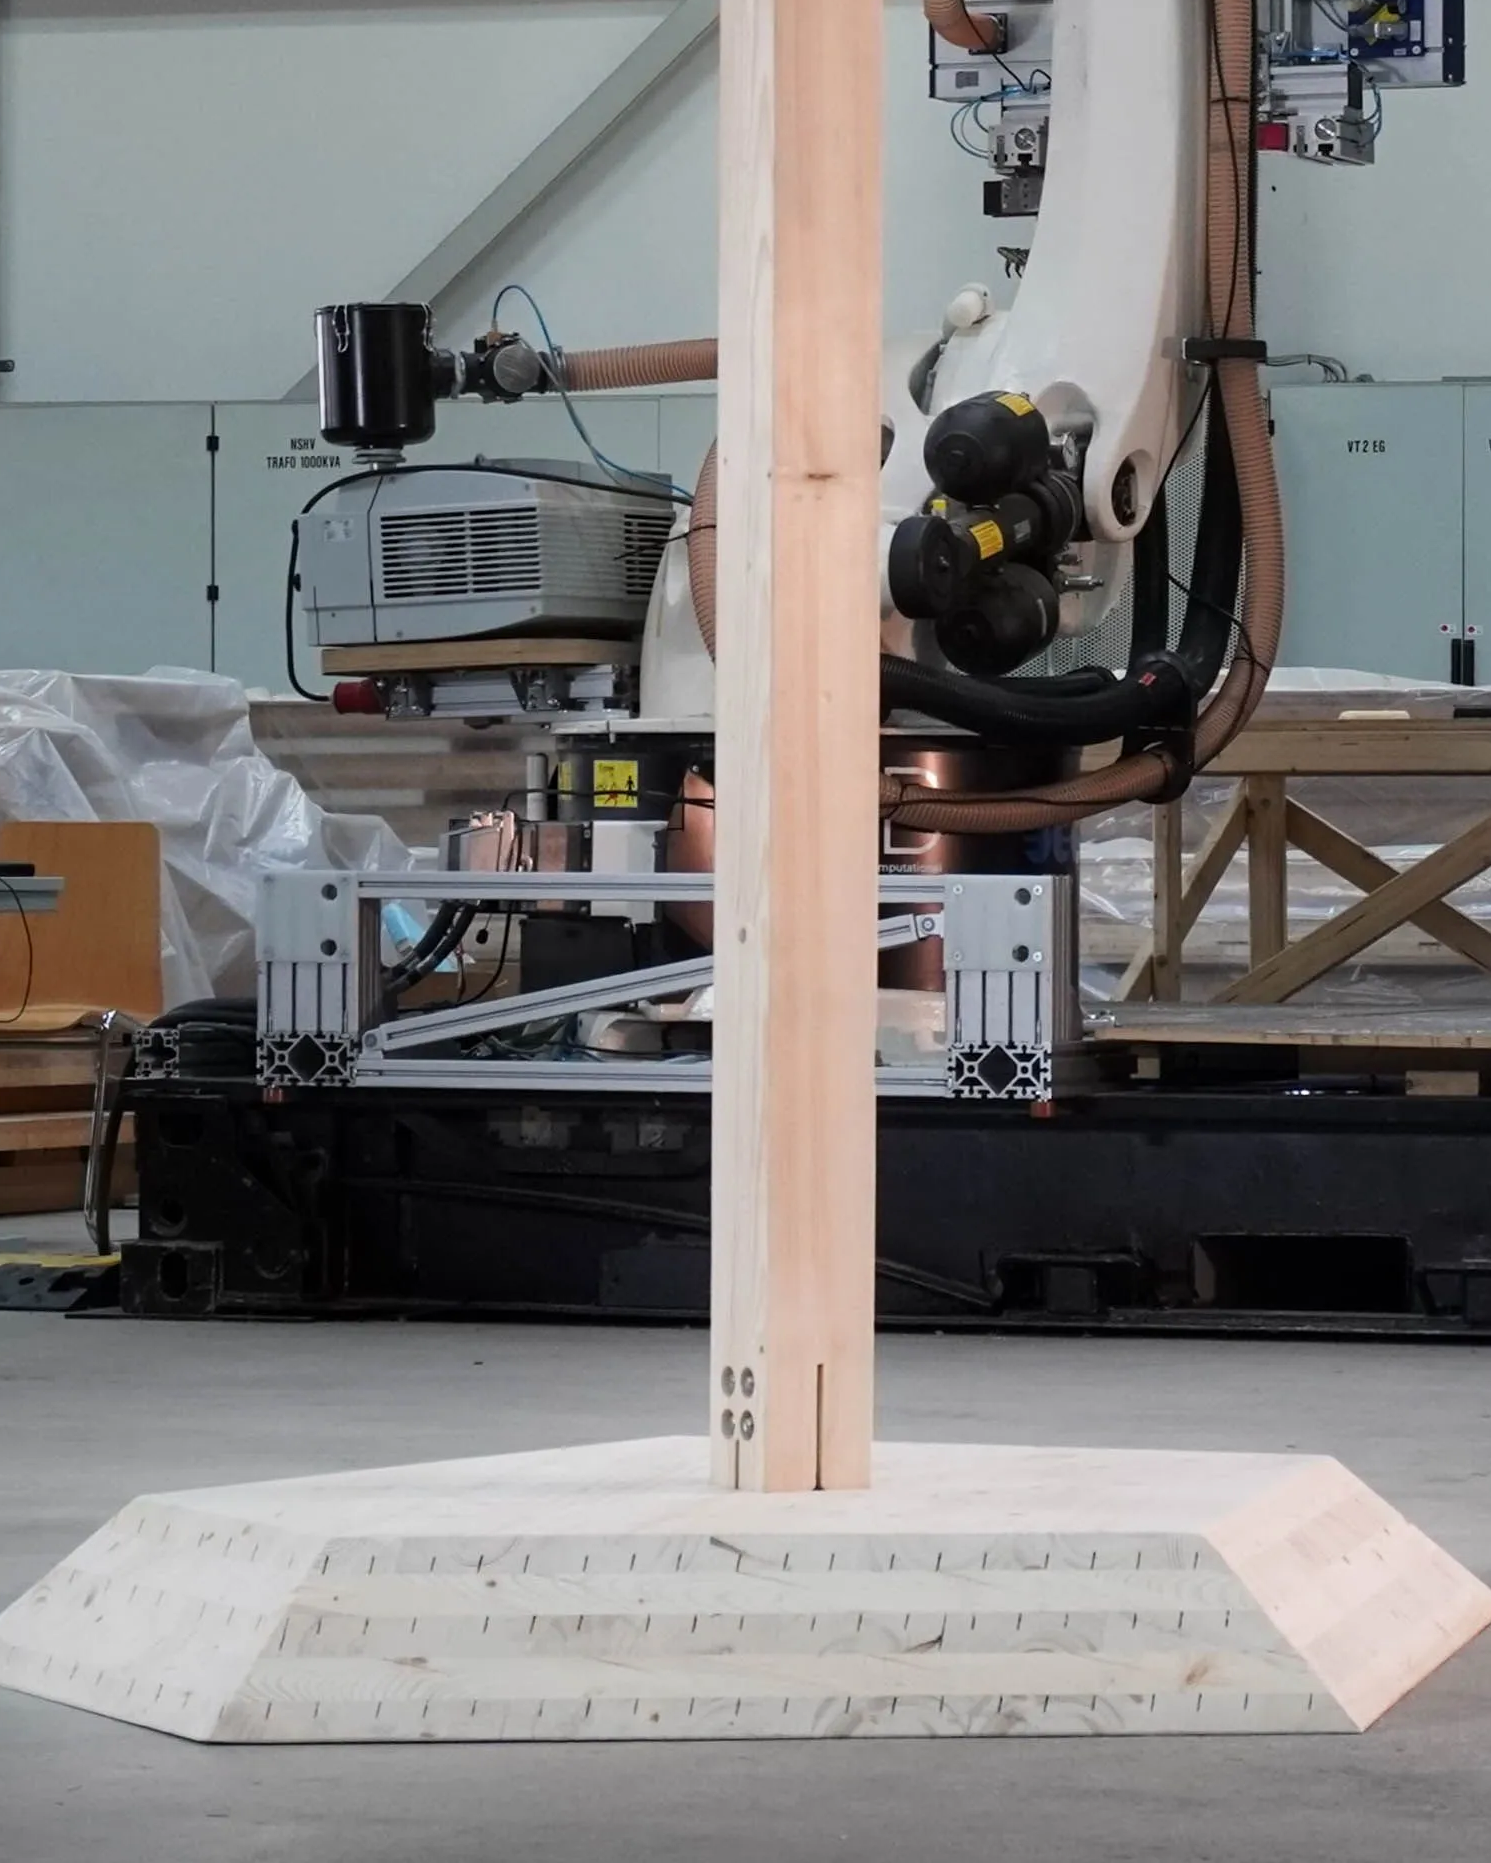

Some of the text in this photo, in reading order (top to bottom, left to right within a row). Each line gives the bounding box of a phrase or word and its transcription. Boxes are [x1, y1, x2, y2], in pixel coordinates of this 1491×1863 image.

[290, 438, 316, 450] NSHV
[1347, 439, 1386, 453] VT 2 EG
[267, 456, 296, 469] TRAFO
